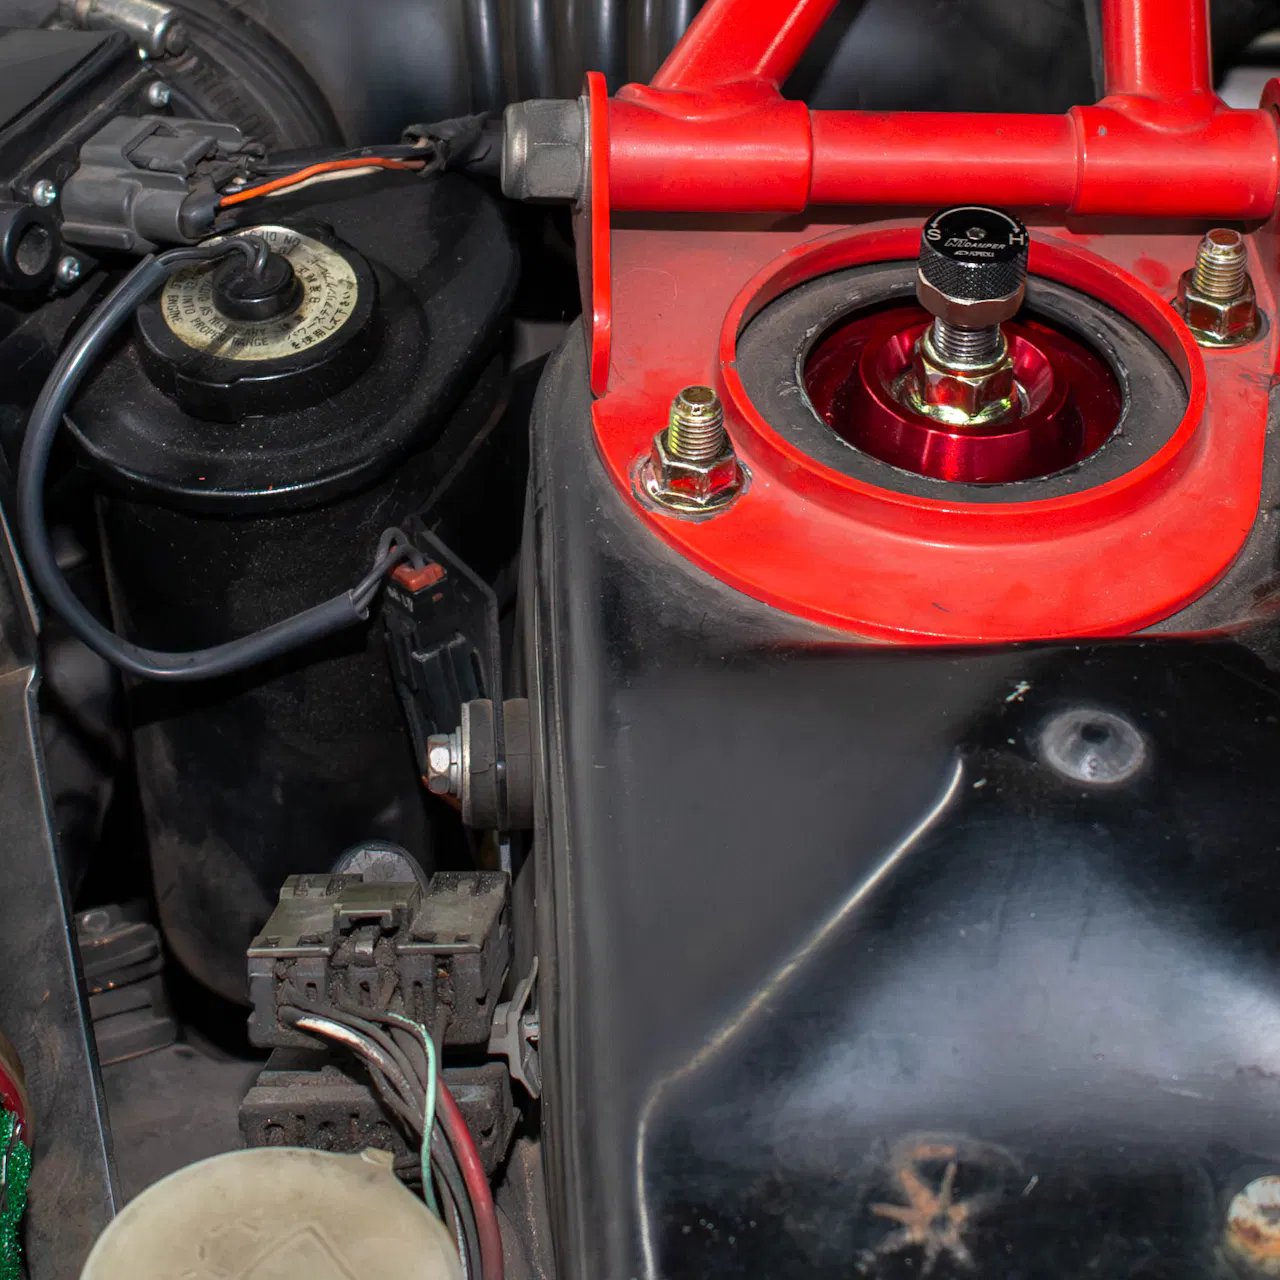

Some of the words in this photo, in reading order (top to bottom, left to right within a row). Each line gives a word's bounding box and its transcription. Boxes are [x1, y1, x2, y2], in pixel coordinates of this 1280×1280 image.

[926, 228, 942, 241] S
[1008, 233, 1024, 246] H
[181, 295, 196, 315] INTO
